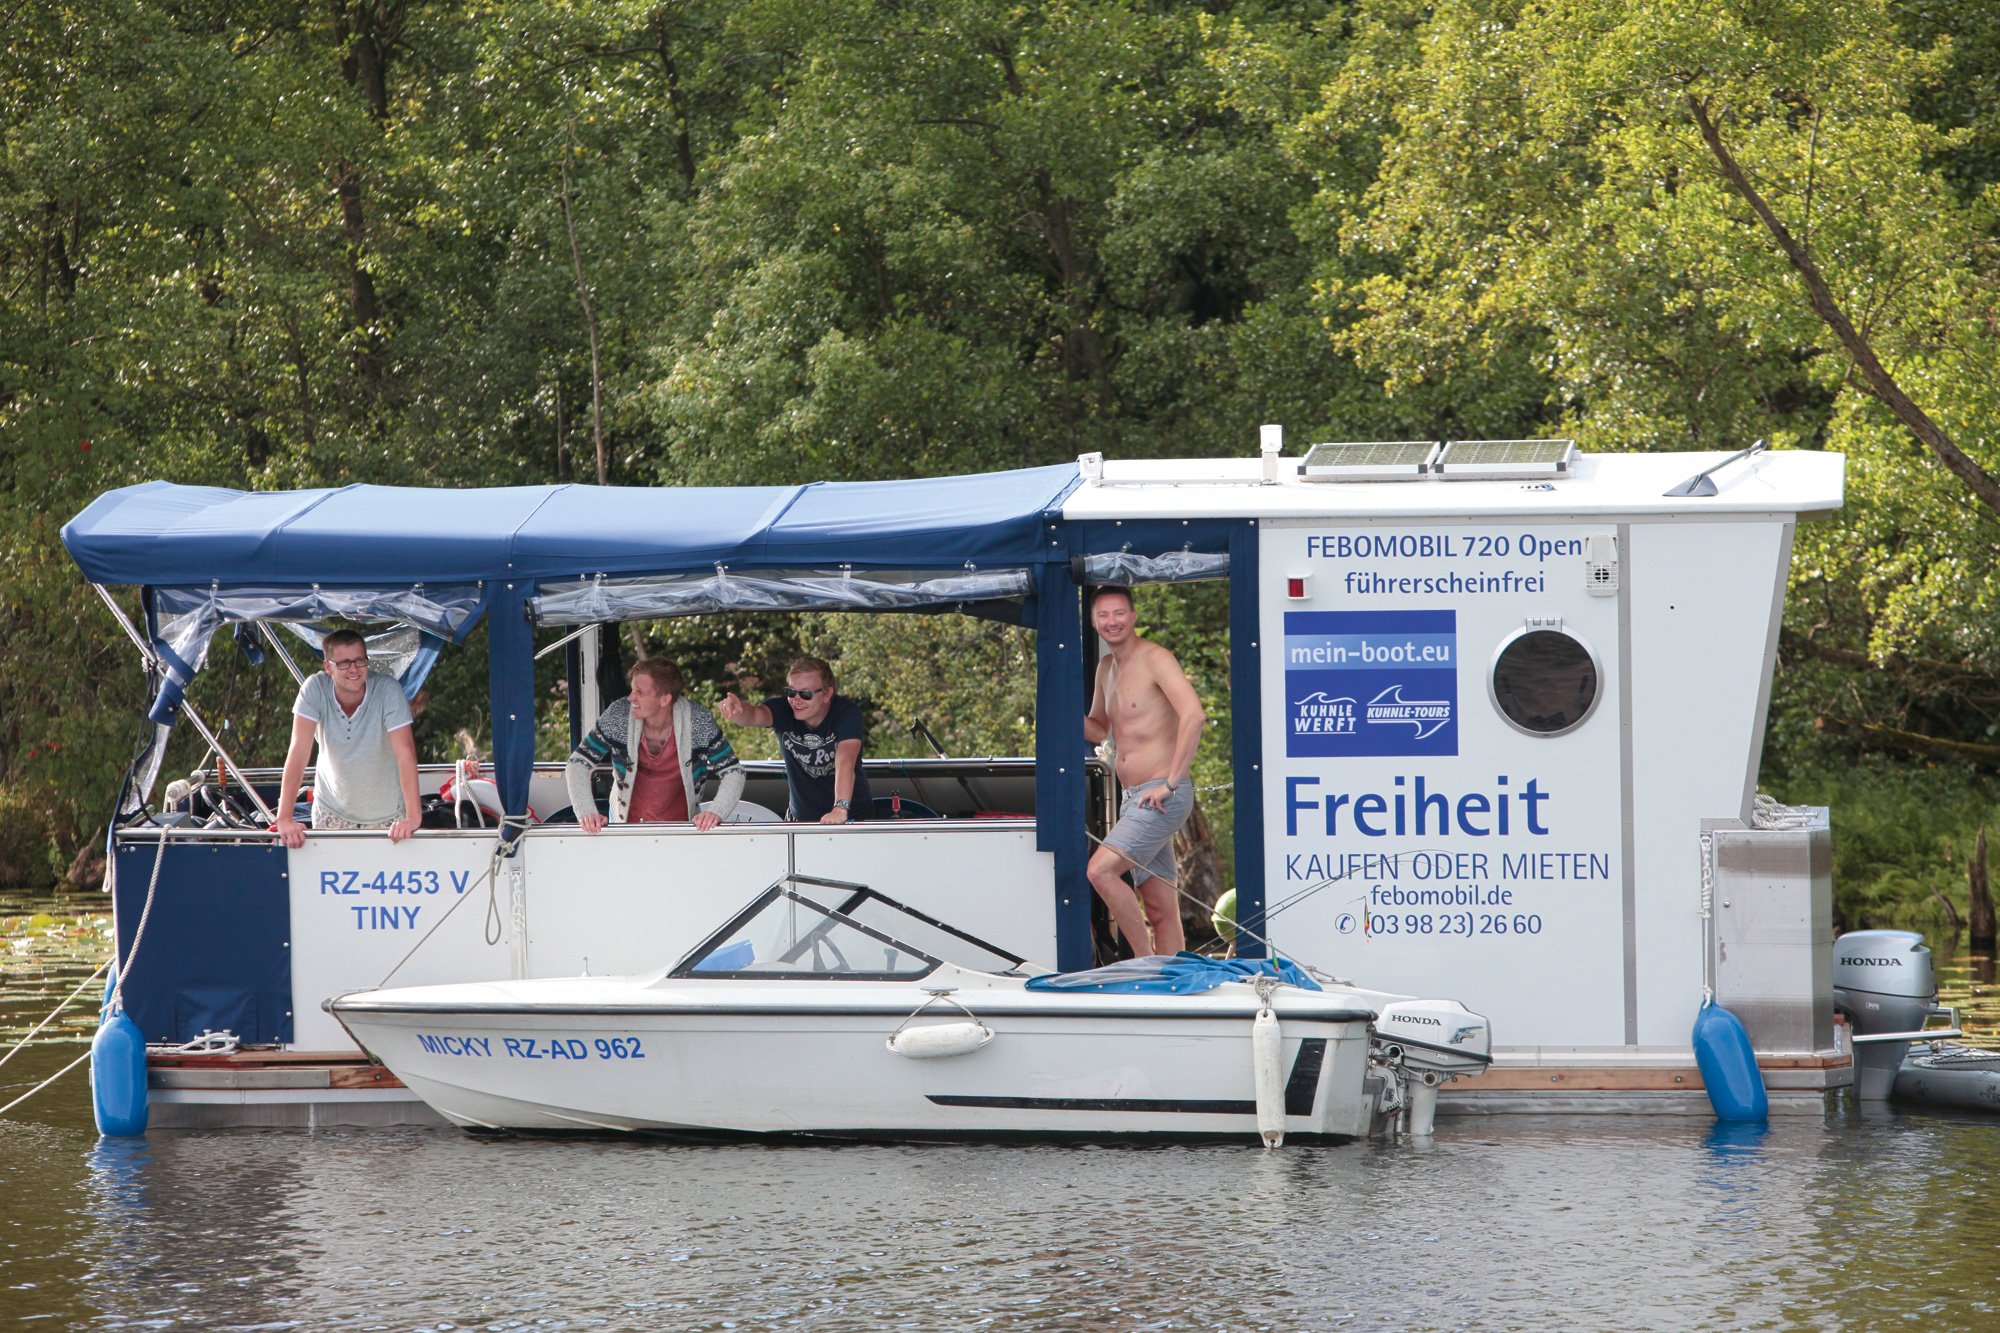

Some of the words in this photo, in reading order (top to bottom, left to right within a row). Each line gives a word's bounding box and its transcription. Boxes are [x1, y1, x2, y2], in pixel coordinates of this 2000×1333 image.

[1307, 534, 1457, 558] FEBOMOBIL
[1462, 535, 1510, 557] 720
[1518, 533, 1582, 562] Open
[1344, 570, 1545, 594] führerscheinfrei
[1291, 641, 1450, 663] mein-boot.eu
[1301, 704, 1353, 717] KUHNLE
[1367, 706, 1450, 718] KUHNLE-TOURS
[1294, 717, 1357, 732] WERFT
[1285, 775, 1550, 836] Freiheit
[1285, 853, 1399, 881] KAUFEN
[1412, 853, 1489, 880] ODER
[1502, 853, 1609, 880] MIETEN
[319, 870, 440, 896] RZ-4453
[449, 870, 470, 895] V
[1371, 884, 1512, 906] febomobil.de
[351, 905, 421, 930] TINY
[1405, 914, 1433, 934] 98
[1439, 911, 1474, 938] 23)
[1479, 914, 1508, 934] 26
[1513, 914, 1542, 934] 60
[1840, 957, 1903, 967] HONDA
[1392, 1014, 1442, 1026] HONDA
[416, 1034, 492, 1057] MICKY
[503, 1037, 588, 1060] RZ-AD
[594, 1036, 646, 1060] 962
